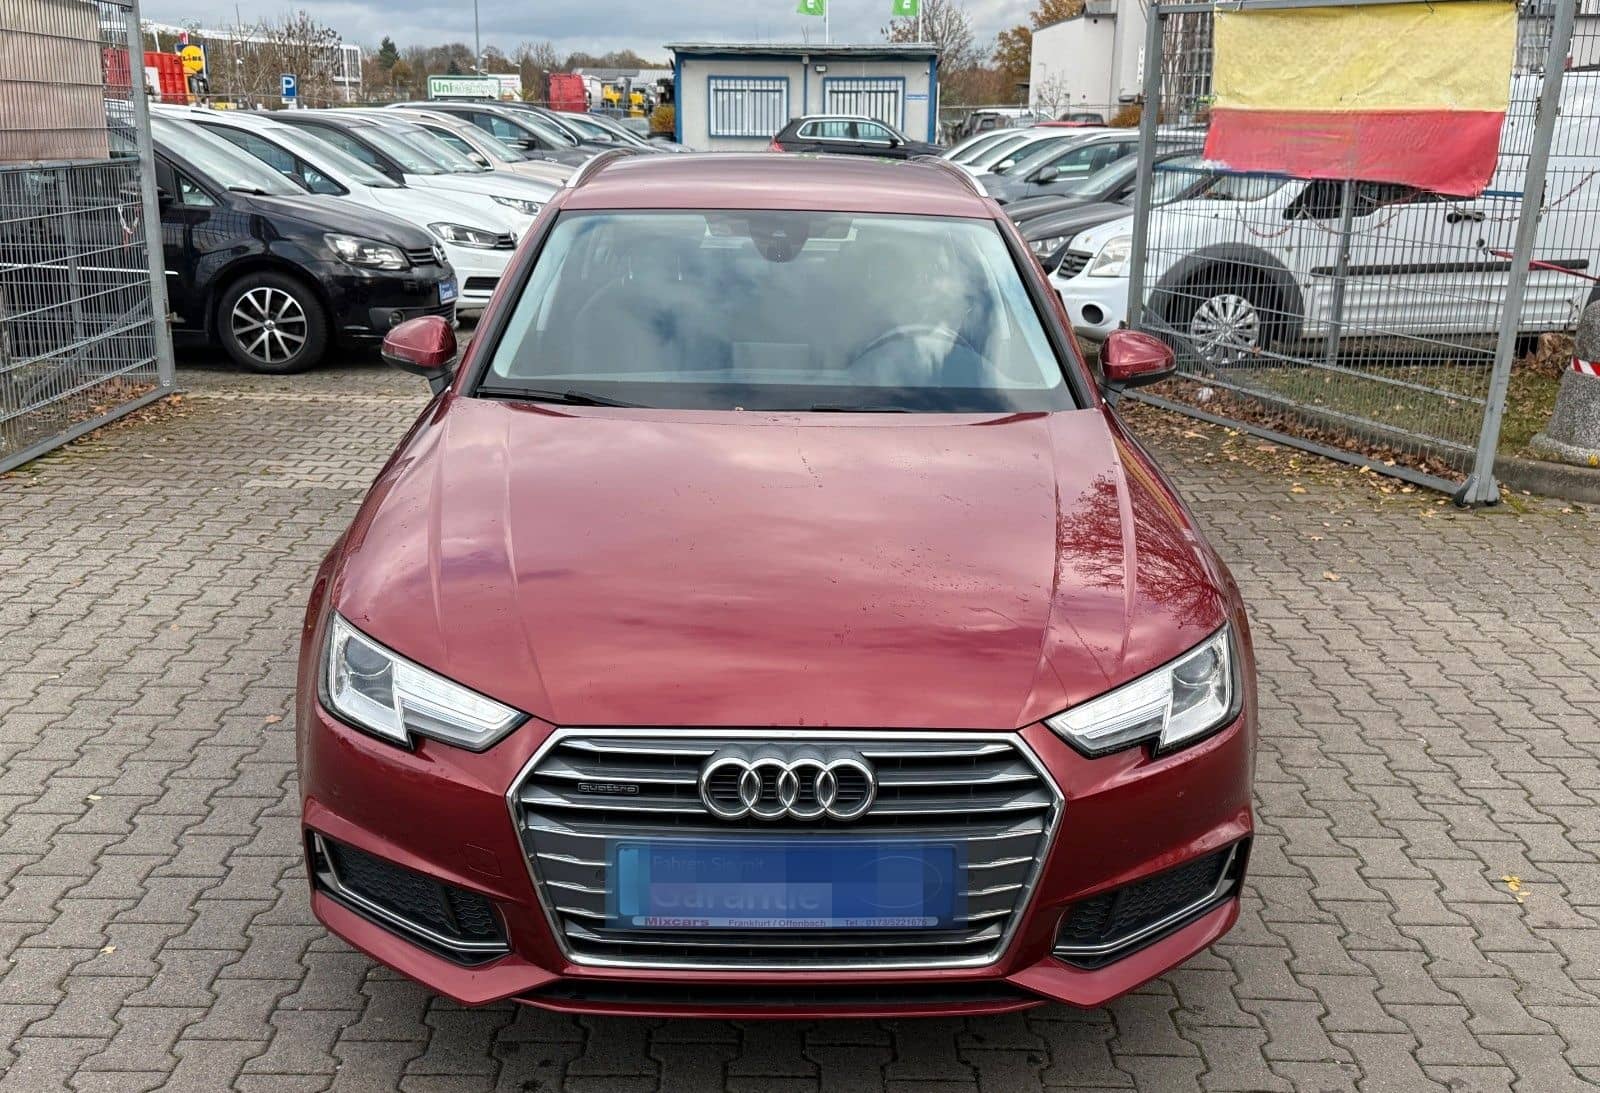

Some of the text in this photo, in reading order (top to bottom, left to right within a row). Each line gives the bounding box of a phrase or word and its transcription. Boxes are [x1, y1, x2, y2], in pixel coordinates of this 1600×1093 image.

[282, 76, 295, 93] P
[579, 783, 637, 793] quattro
[645, 917, 710, 927] Mixcars
[728, 919, 770, 928] Frankfurt
[779, 919, 826, 928] Offenbach
